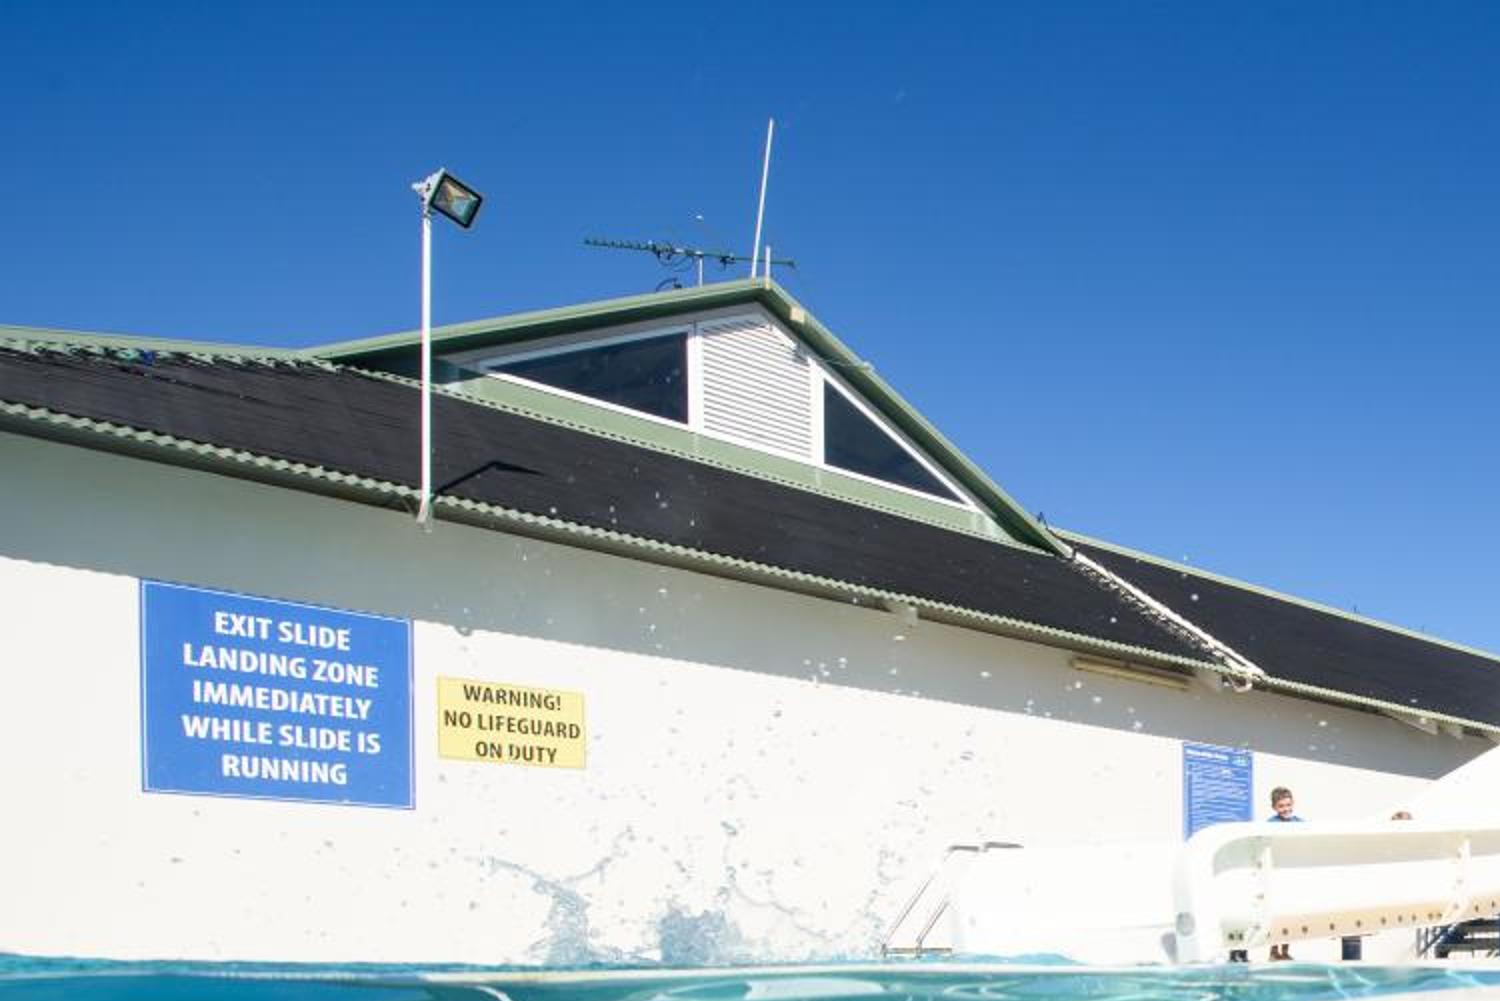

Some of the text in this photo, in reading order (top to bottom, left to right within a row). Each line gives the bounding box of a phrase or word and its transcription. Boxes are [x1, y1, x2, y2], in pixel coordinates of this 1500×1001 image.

[215, 611, 350, 651] EXIT SLIDE
[183, 643, 379, 688] LANDING ZONE
[193, 680, 372, 720] IMMEDIATELY
[463, 683, 562, 711] WARNING!
[182, 714, 381, 755] WHILE SLIDE IS
[444, 709, 581, 739] NO LIFEGUARD
[222, 753, 347, 785] RUNNING
[475, 741, 558, 763] ON DUTY
